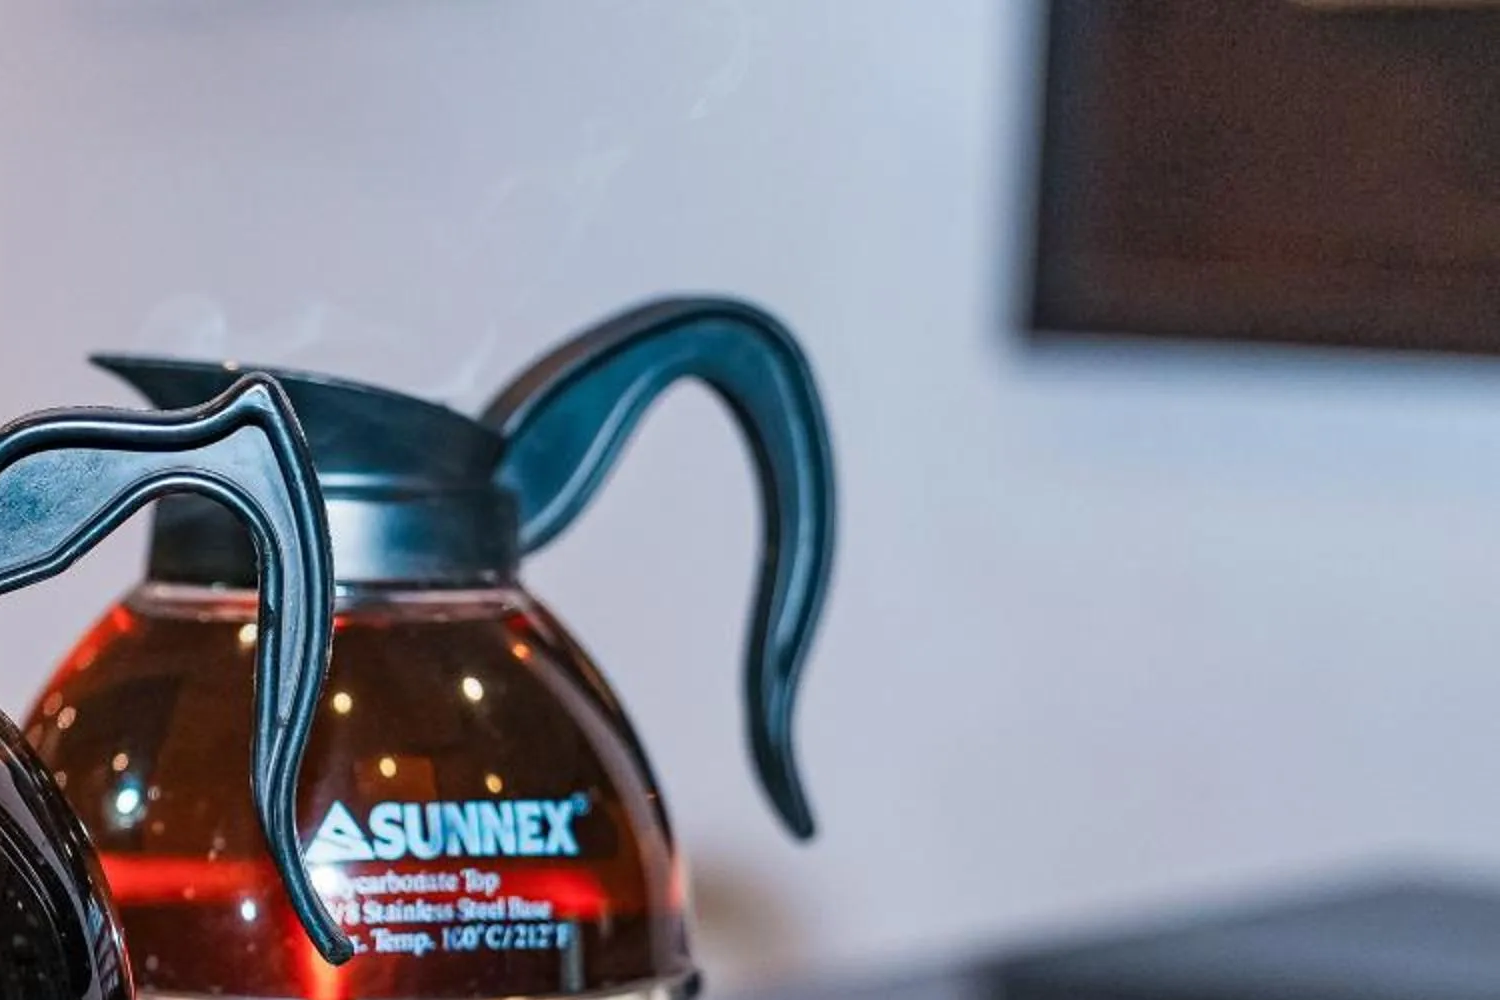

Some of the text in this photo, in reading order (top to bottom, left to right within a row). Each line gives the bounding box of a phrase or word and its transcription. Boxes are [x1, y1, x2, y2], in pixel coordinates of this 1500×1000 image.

[460, 867, 501, 896] Top
[362, 899, 454, 924] Stainless
[456, 897, 506, 924] Steel
[508, 896, 552, 921] Base
[371, 927, 436, 956] Temp.
